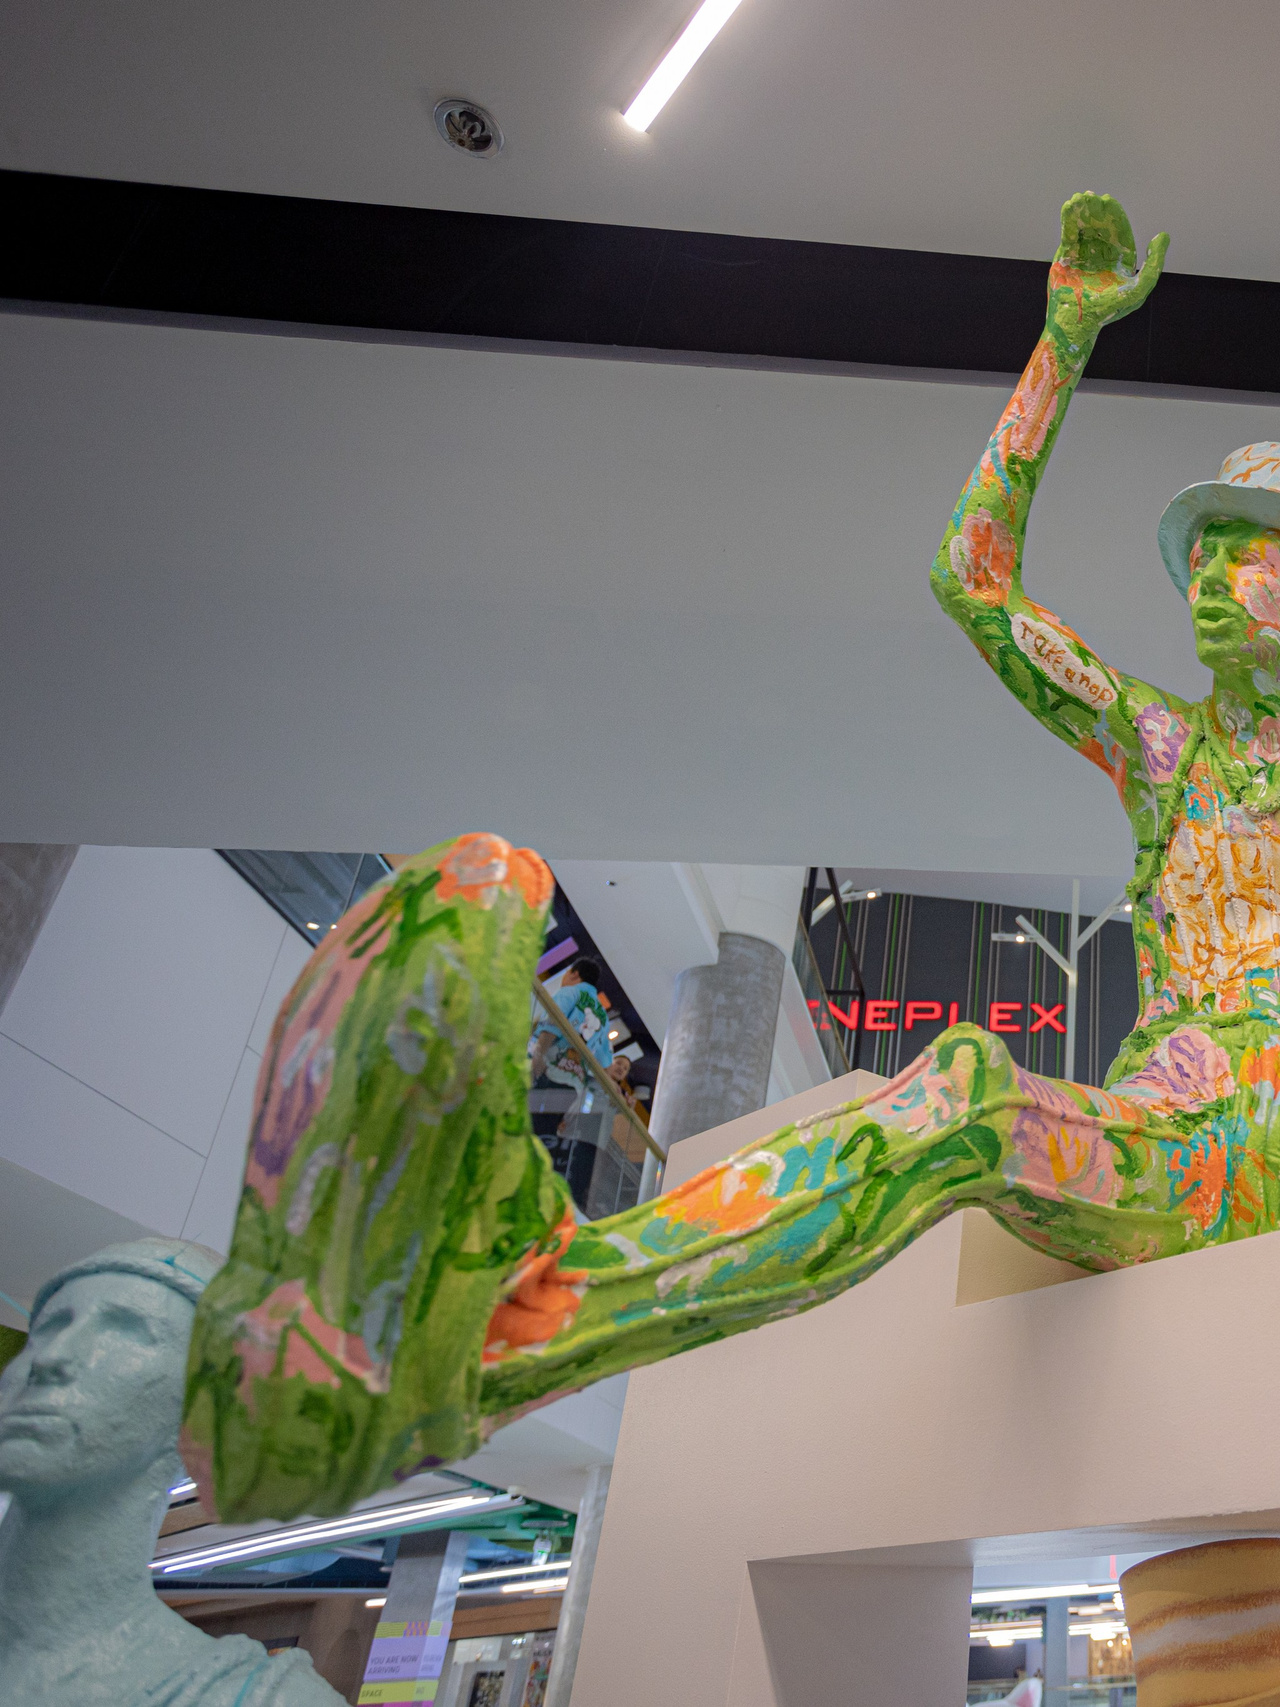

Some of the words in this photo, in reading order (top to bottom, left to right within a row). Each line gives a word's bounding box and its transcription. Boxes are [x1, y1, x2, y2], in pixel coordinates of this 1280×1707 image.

[1065, 668, 1076, 683] a
[1079, 672, 1114, 704] nap
[401, 1654, 419, 1663] NOW
